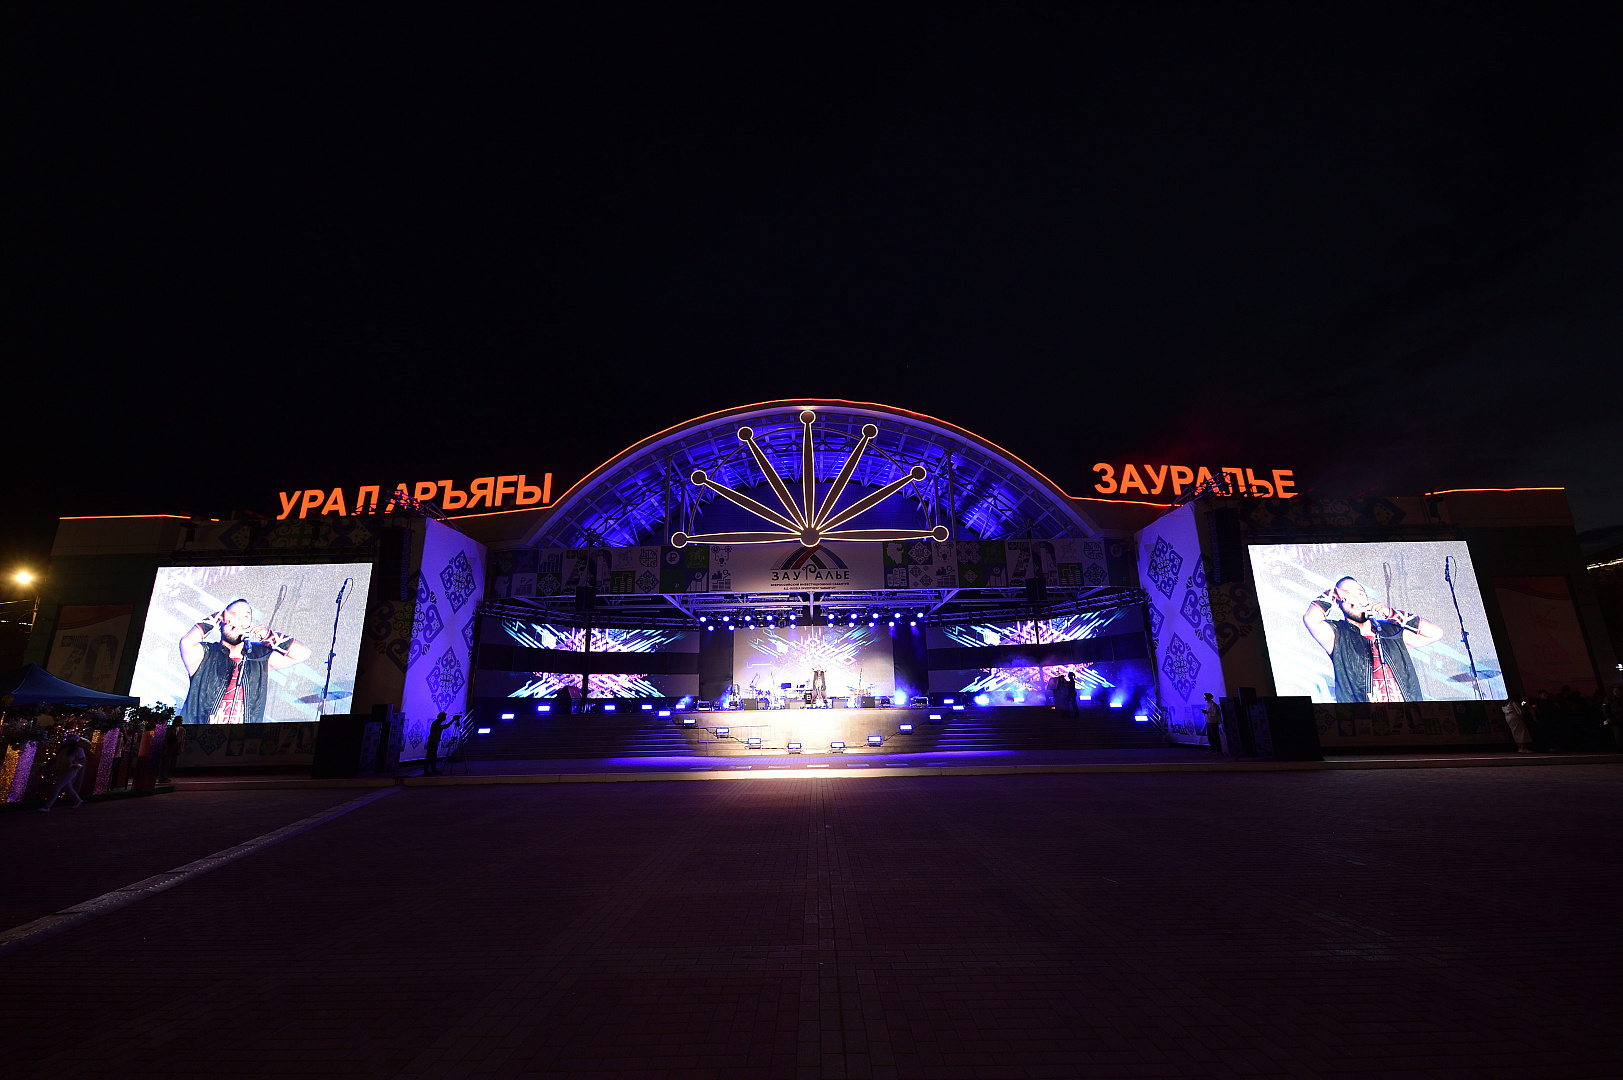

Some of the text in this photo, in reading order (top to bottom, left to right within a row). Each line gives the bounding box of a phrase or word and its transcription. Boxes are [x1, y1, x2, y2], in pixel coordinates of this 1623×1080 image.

[1092, 462, 1299, 499] ЗАУРАЛЬЕ
[276, 485, 381, 520] УРАЛ
[771, 563, 850, 581] ЗАУРАЛЬЕ
